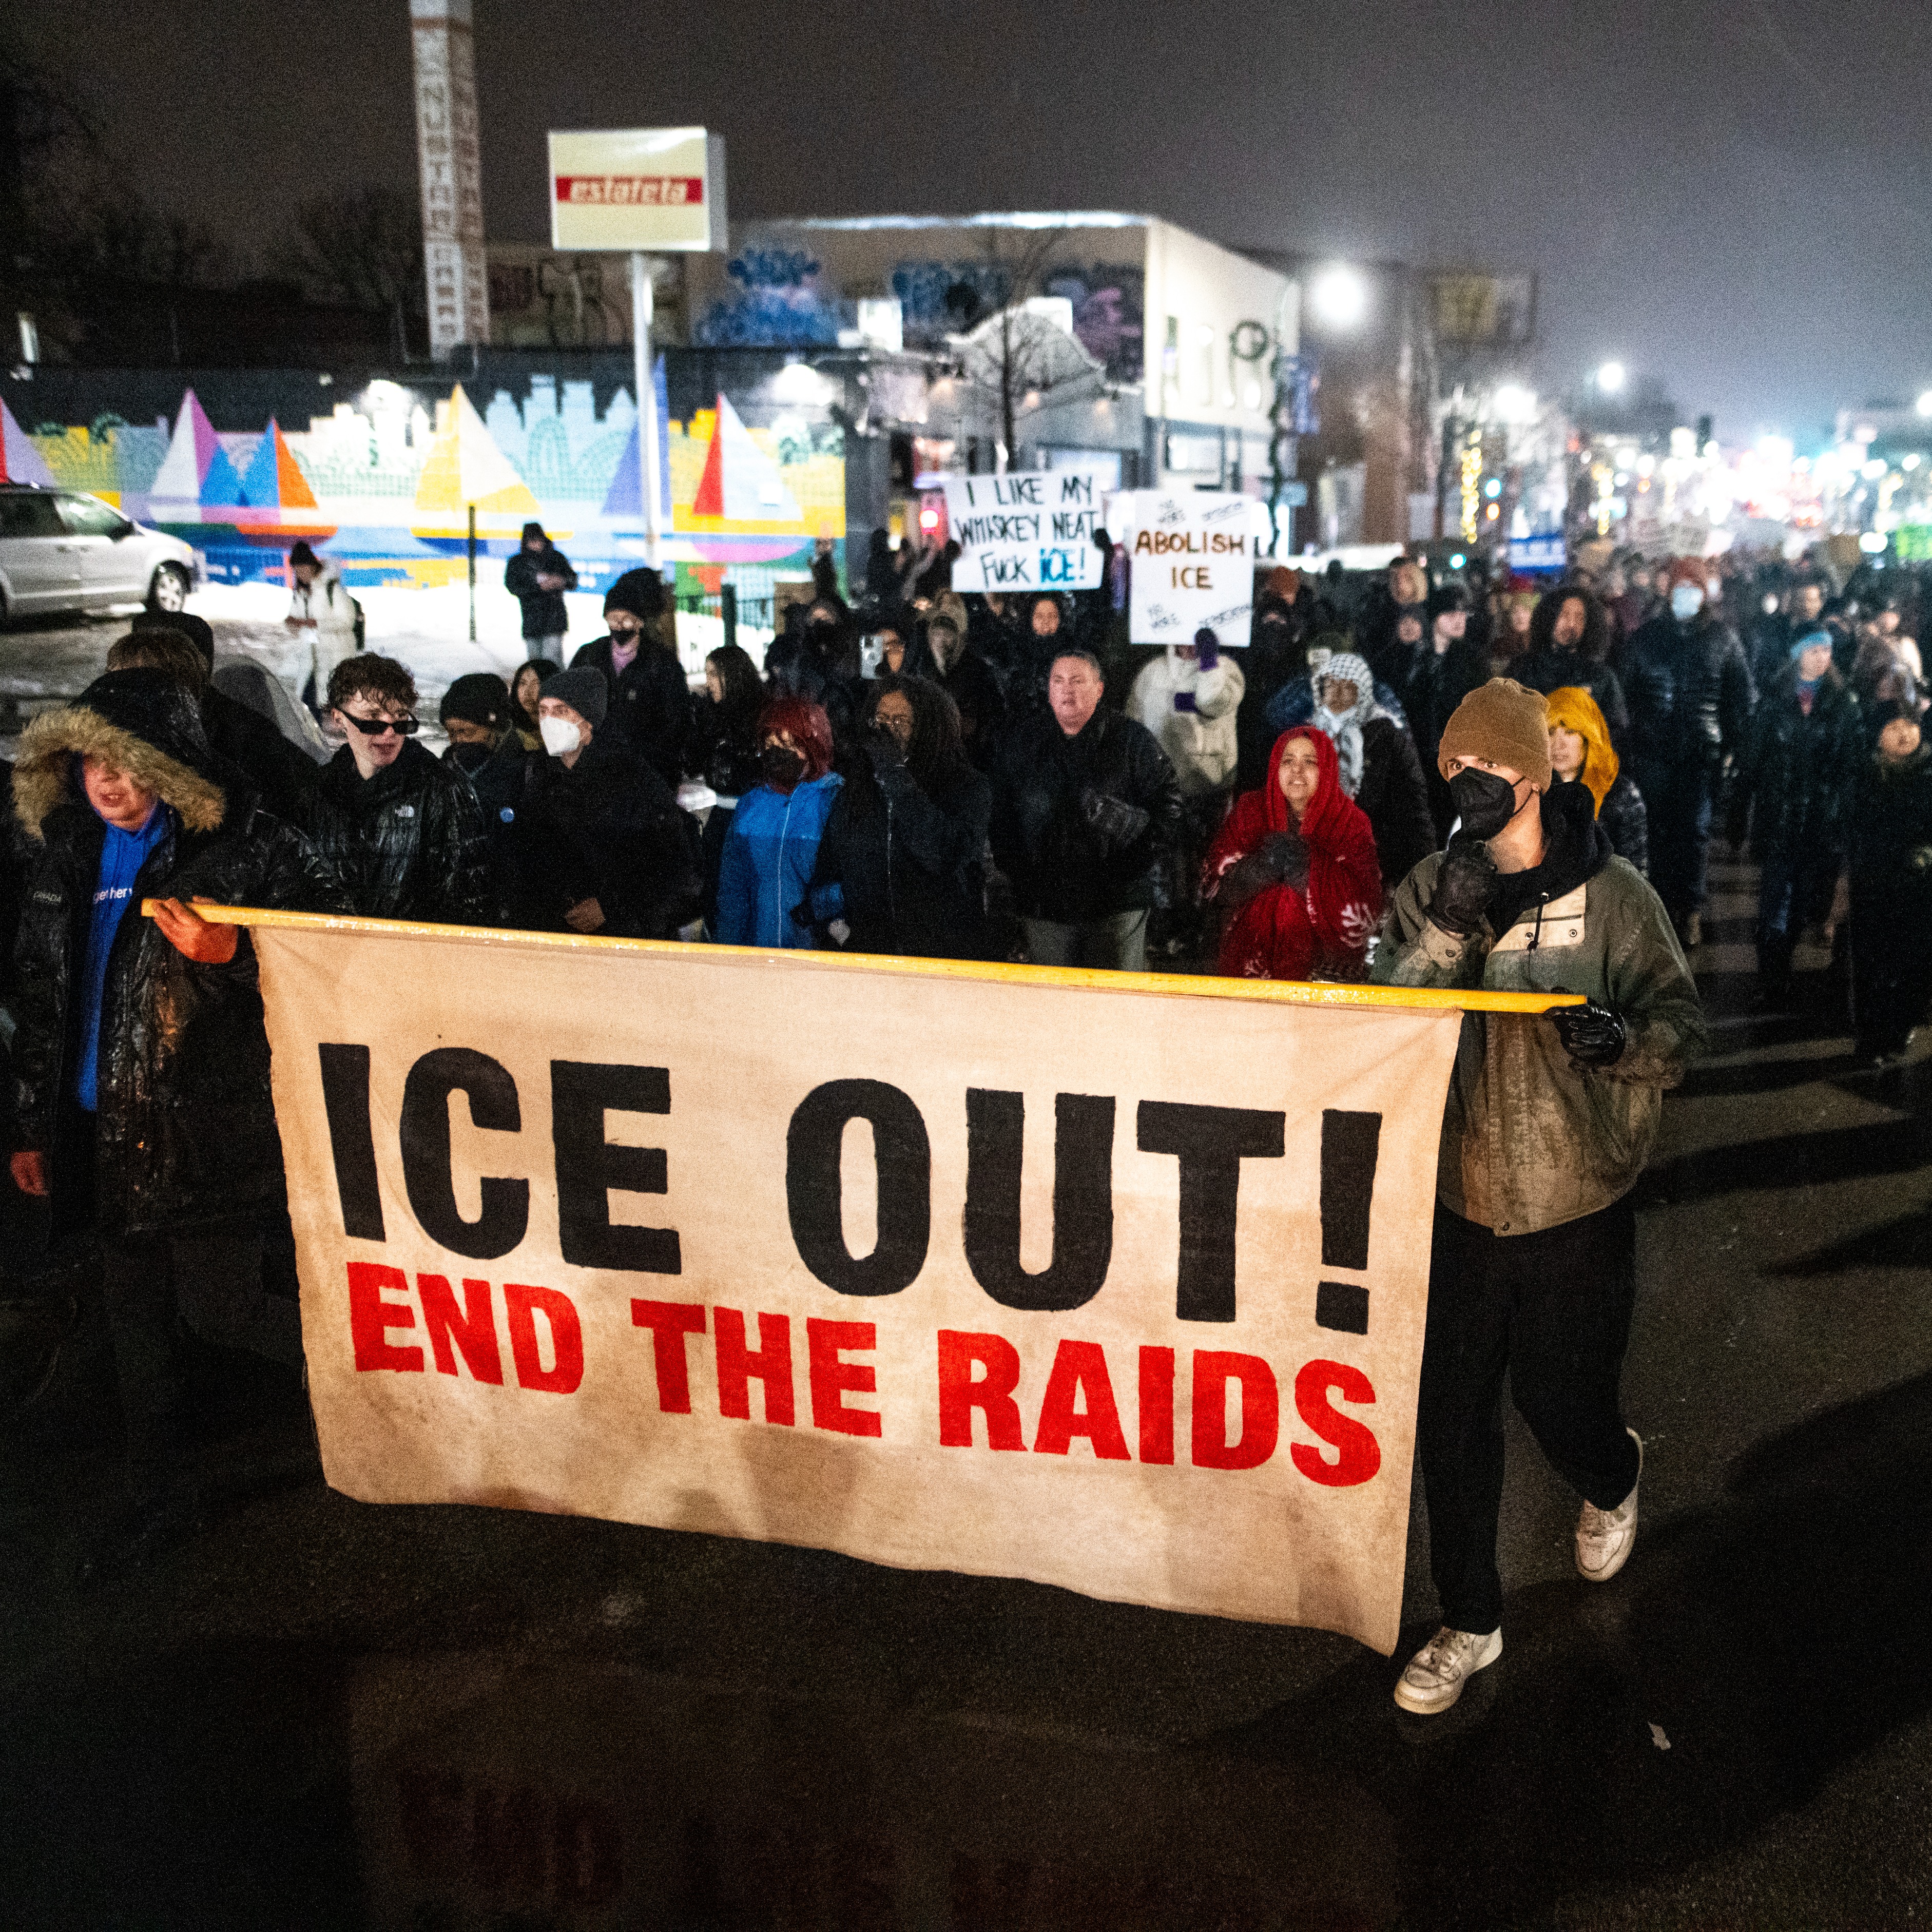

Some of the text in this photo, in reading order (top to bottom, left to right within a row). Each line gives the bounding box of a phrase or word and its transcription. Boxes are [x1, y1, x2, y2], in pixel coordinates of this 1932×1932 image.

[571, 176, 687, 204] estafeta
[965, 476, 1092, 507] I LIKE MY
[954, 511, 1098, 546] WHISKEY NEAT
[1134, 529, 1245, 556] ABOLISH
[1171, 566, 1213, 589] ICE
[319, 1044, 1382, 1335] ICE OUT!
[346, 1262, 1381, 1487] END THE RAIDS
